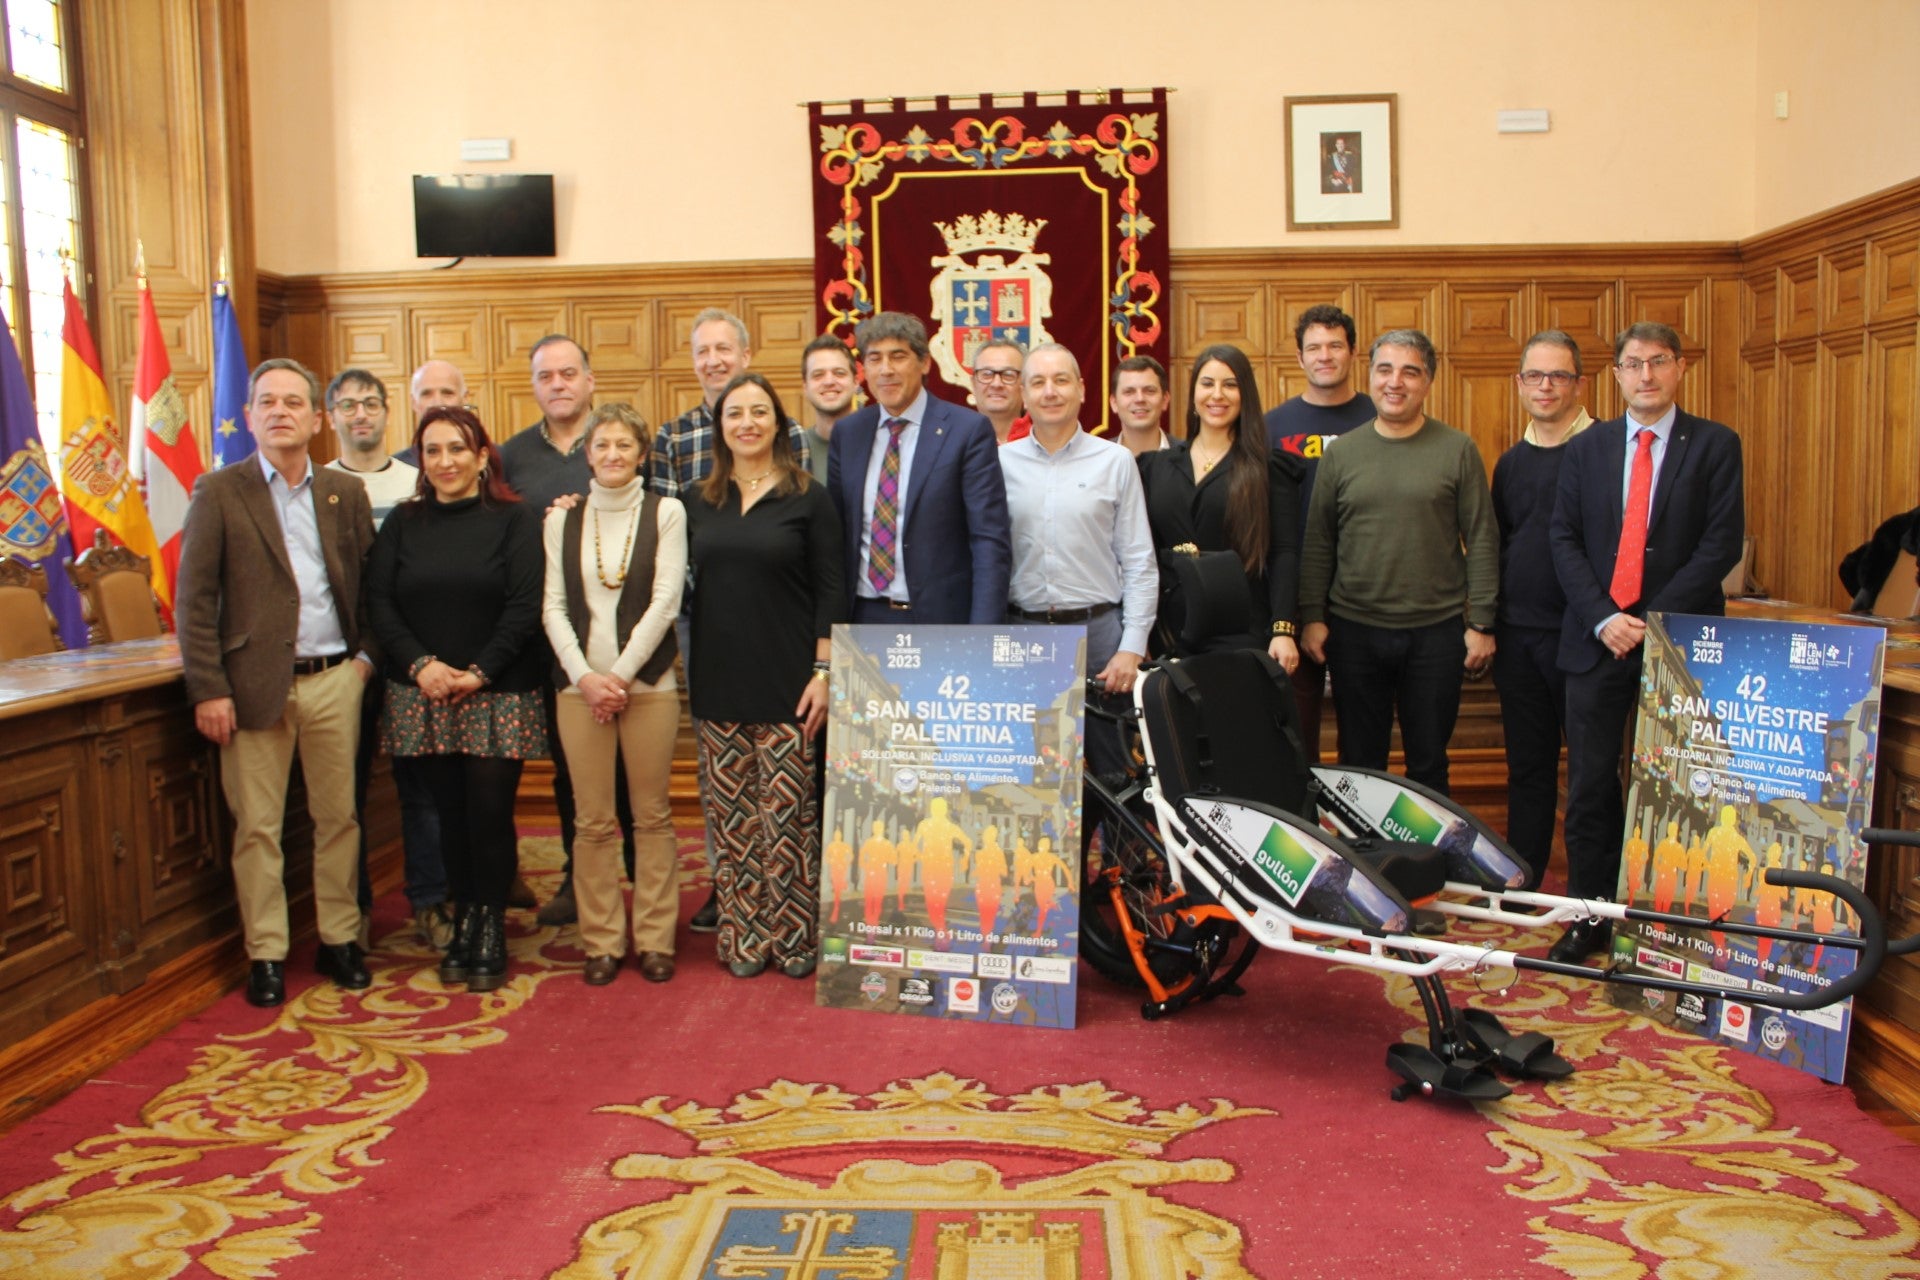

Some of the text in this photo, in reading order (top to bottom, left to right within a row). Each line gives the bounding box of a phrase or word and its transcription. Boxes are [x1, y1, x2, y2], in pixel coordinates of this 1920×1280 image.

[895, 633, 912, 647] 31
[1701, 625, 1716, 641] 31
[1692, 640, 1724, 650] DICIEMBRE
[1692, 647, 1723, 665] 2023
[887, 654, 922, 668] 2023
[938, 675, 970, 699] 42
[1736, 673, 1767, 702] 42
[865, 700, 1037, 722] SAN SILVESTRE
[1671, 694, 1829, 734] SAN SILVESTRE
[891, 722, 1015, 744] PALENTINA
[1690, 720, 1805, 756] PALENTINA
[920, 751, 976, 764] INCLUSIVA
[977, 753, 985, 763] Y
[986, 753, 1045, 765] ADAPTADA
[1715, 754, 1766, 773] INCLUSIVA
[1768, 762, 1776, 774] Y
[1776, 764, 1833, 784] ADAPTADA
[919, 770, 1019, 784] Banco de Alimentos
[1712, 774, 1807, 800] Banco de Alimentos
[919, 783, 961, 794] Palencia
[1712, 788, 1750, 804] Palencia
[1255, 849, 1300, 893] gullón
[848, 921, 1058, 947] 1 Dorsal x 1 Kilo o 1 Litro de alimentos
[1638, 923, 1832, 988] 1 Dorsal x 1 Kilo o 1 Litro de alimentos
